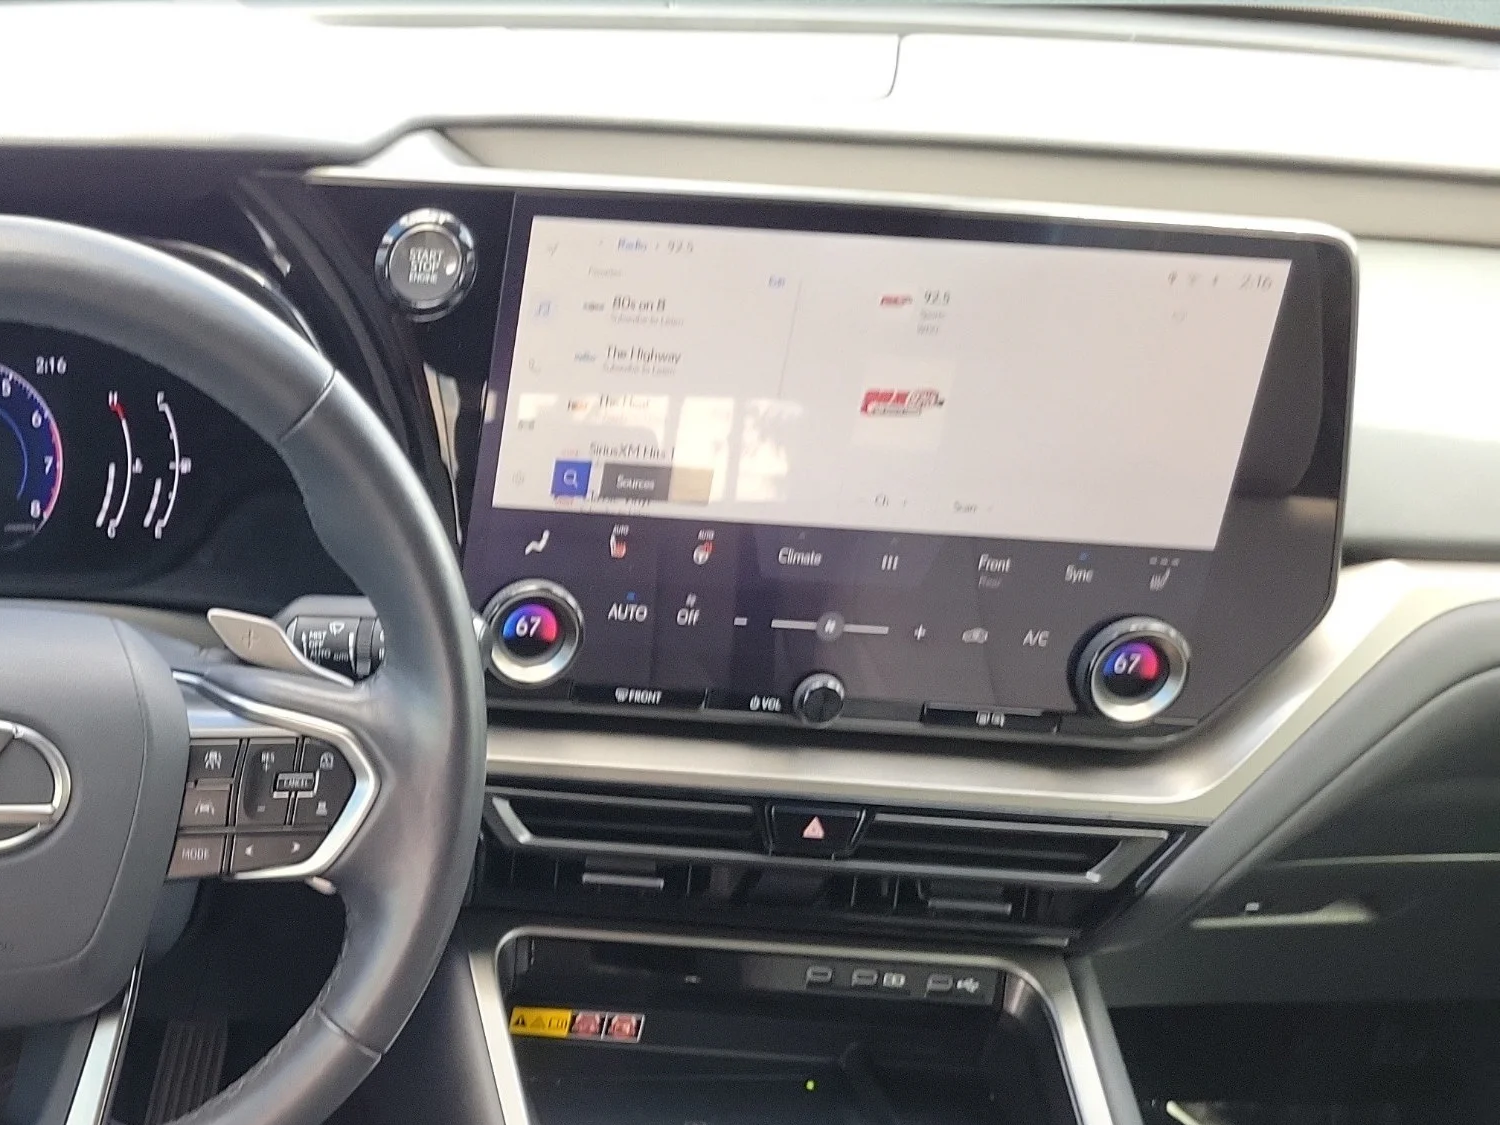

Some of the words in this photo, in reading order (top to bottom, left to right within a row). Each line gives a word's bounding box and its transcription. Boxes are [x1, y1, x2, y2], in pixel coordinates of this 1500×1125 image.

[409, 247, 444, 261] START
[410, 260, 439, 272] STOP
[606, 345, 627, 360] The
[630, 346, 681, 365] Highway
[36, 356, 67, 374] 2:16
[31, 409, 42, 428] 6
[44, 456, 53, 475] 7
[616, 473, 655, 491] Sources
[30, 500, 41, 518] 8
[778, 547, 822, 566] Climate
[978, 554, 1011, 573] Front
[1065, 565, 1094, 584] Sync
[608, 604, 647, 622] AUTO
[677, 607, 700, 626] Off
[515, 615, 541, 638] 67
[1022, 630, 1050, 648] A/C
[1114, 652, 1141, 675] 67
[629, 690, 662, 704] FRONT
[762, 697, 781, 712] VOL
